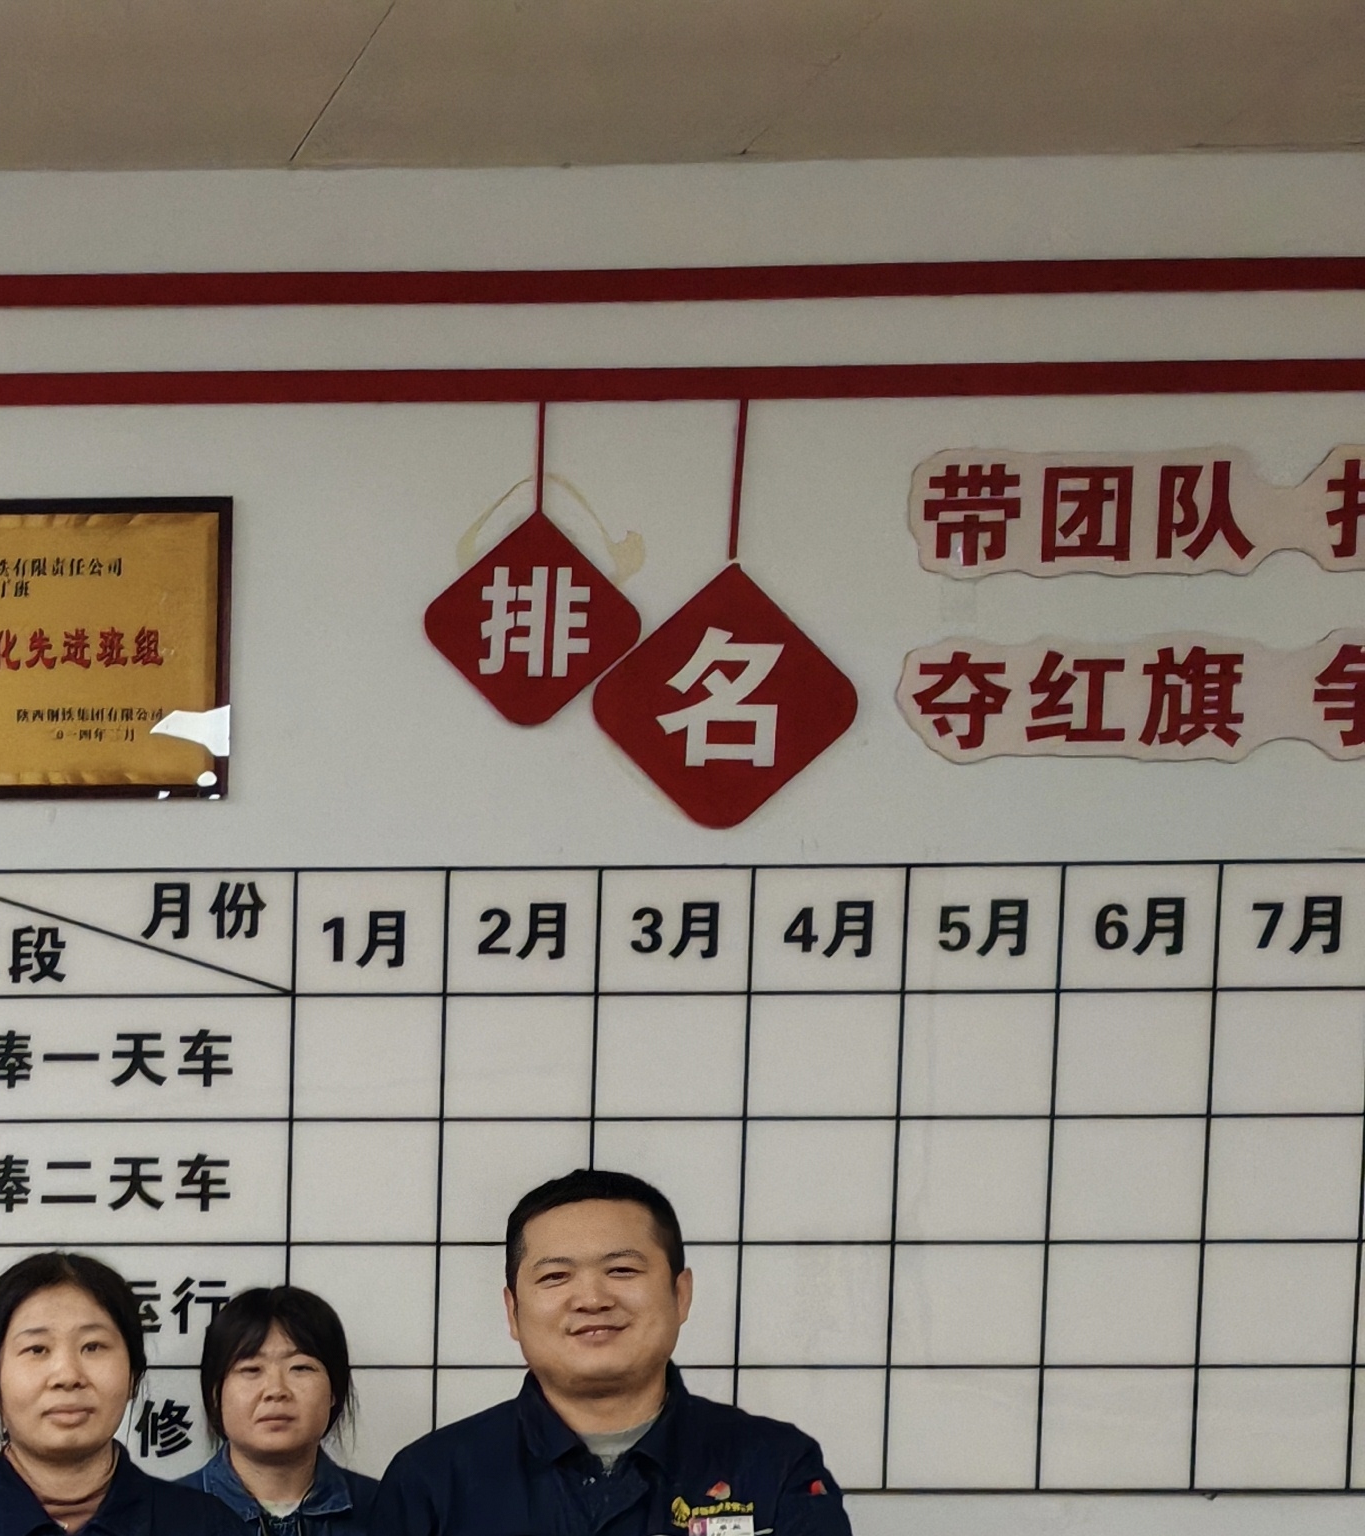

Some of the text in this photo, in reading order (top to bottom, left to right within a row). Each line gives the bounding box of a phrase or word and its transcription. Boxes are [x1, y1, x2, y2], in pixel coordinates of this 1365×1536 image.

[923, 461, 1256, 566] 带团队
[478, 566, 786, 768] 排名
[912, 646, 1246, 749] 夺红旗
[141, 881, 267, 940] 月份
[322, 909, 407, 968] 1月
[477, 901, 569, 961] 2月
[630, 900, 721, 959] 3月
[783, 900, 875, 958] 4月
[937, 898, 1030, 957] 5月
[1093, 896, 1188, 956] 6月
[1251, 895, 1344, 954] 7月
[134, 1398, 194, 1458] 修
